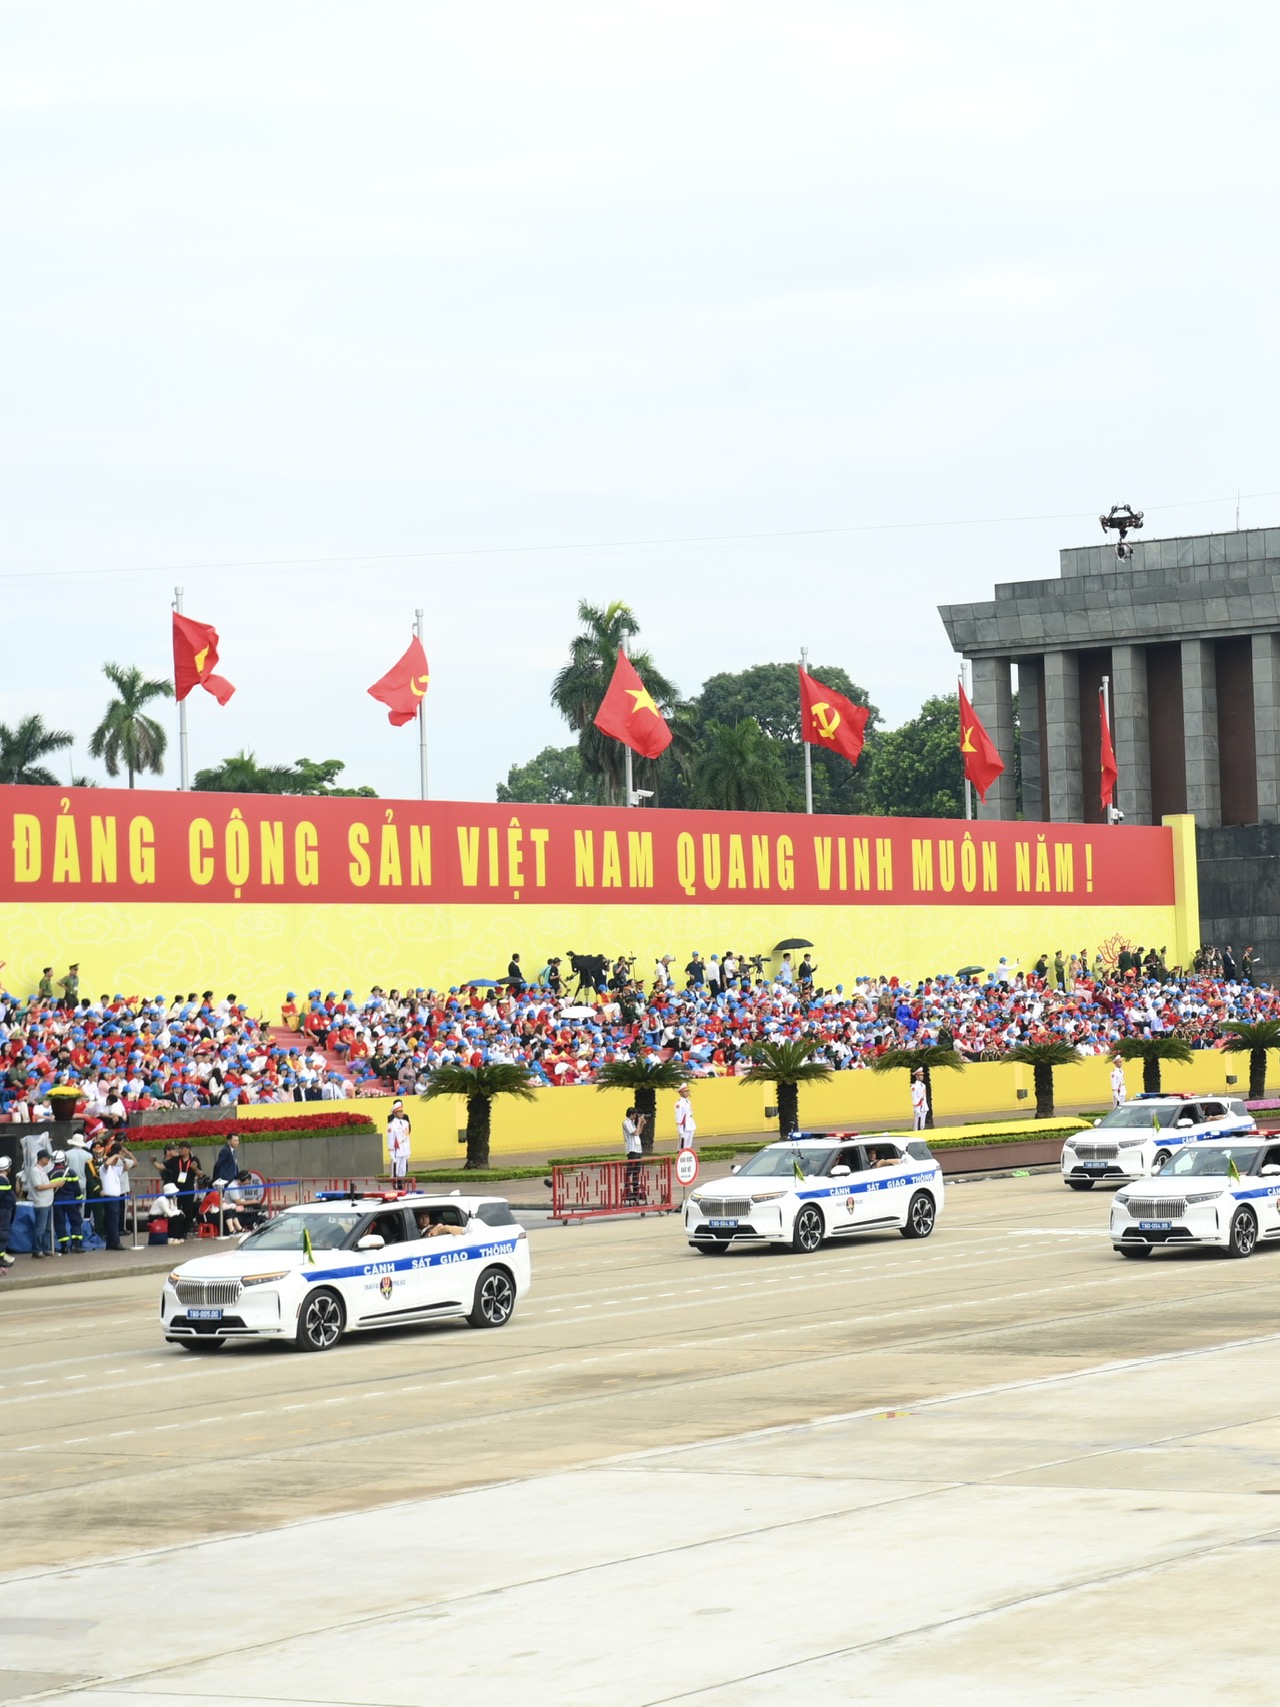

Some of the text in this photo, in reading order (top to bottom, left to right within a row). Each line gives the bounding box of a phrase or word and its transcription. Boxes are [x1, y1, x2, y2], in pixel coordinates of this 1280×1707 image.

[12, 797, 156, 885] ĐẢNG
[188, 807, 320, 899] CỘNG
[348, 808, 432, 887] SẢN
[457, 816, 550, 900] VIỆT
[574, 829, 654, 888] NAM
[676, 831, 795, 896] QUANG
[814, 836, 893, 891] VINH
[912, 831, 998, 893] MUÔN
[867, 1183, 880, 1192] SÁT
[887, 1179, 906, 1189] GIAO
[363, 1243, 513, 1275] CẢNH SÁT GIAO THÔNG
